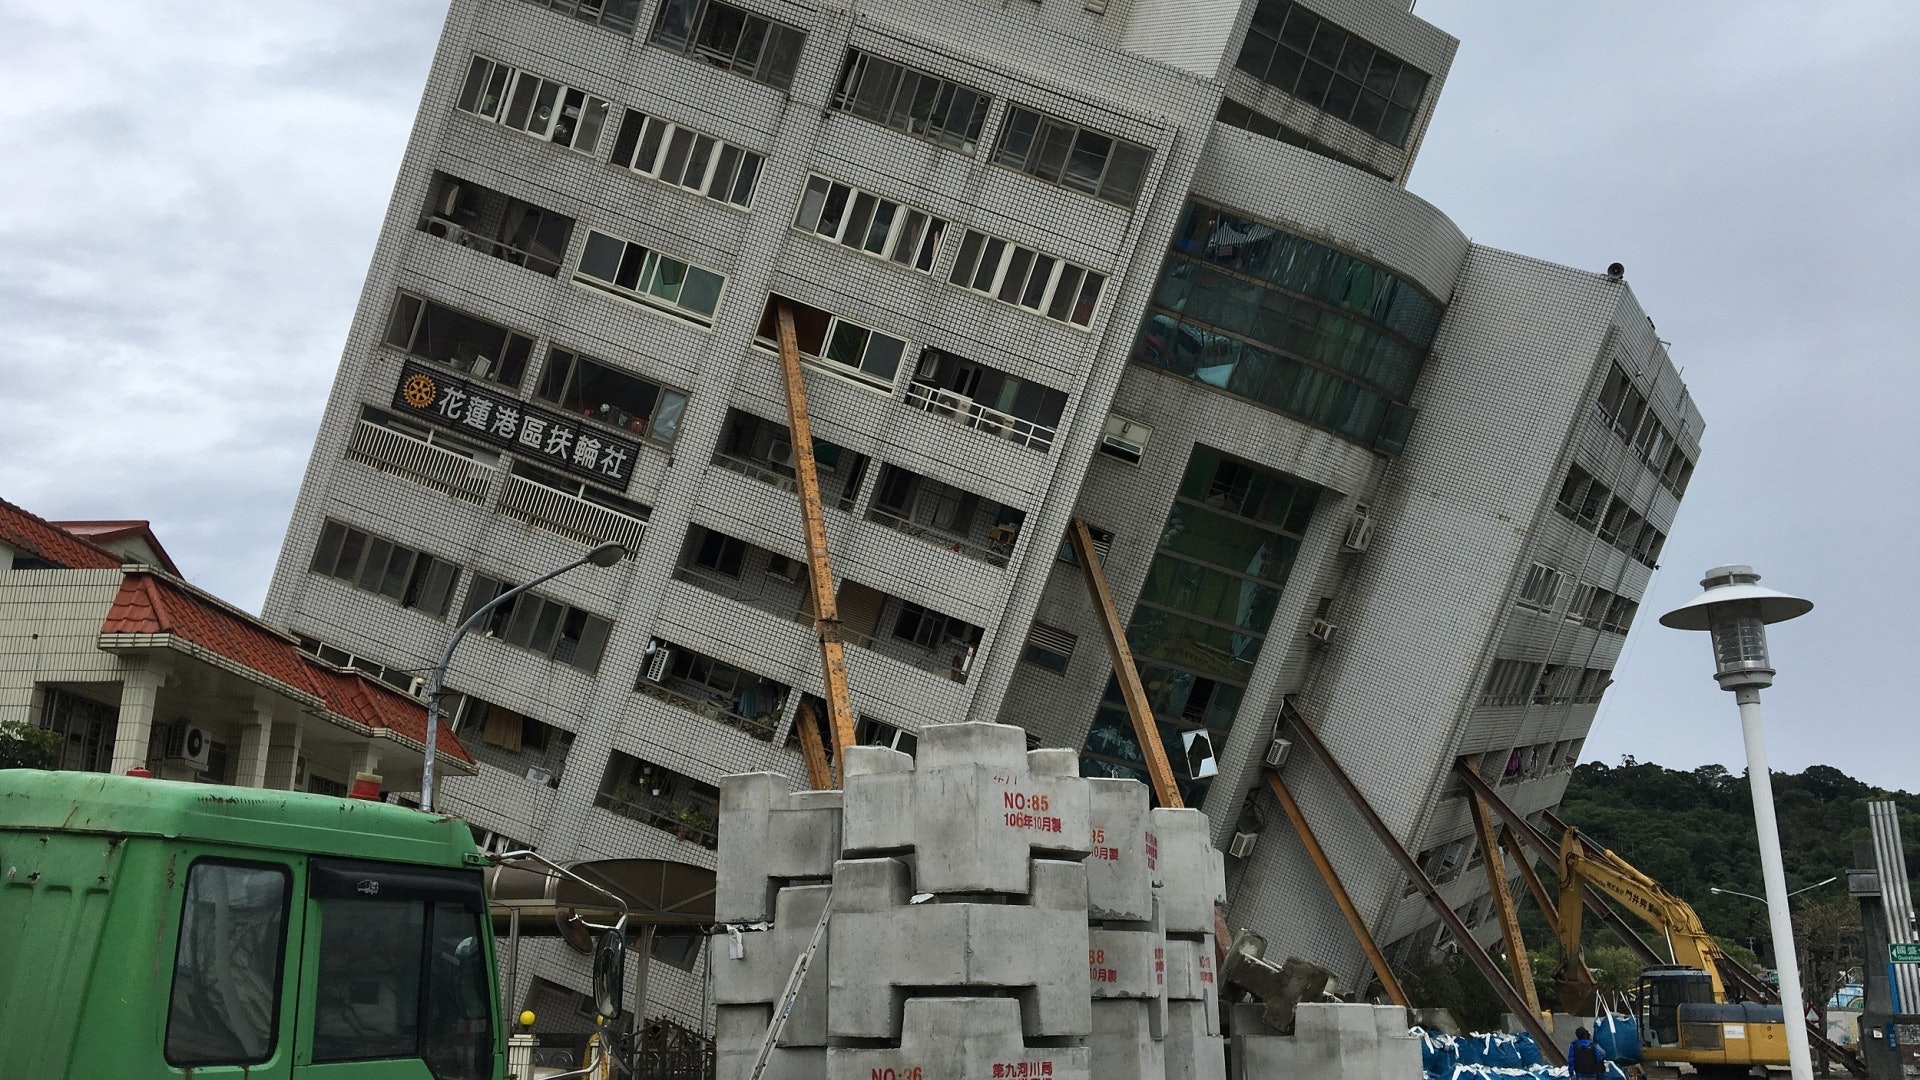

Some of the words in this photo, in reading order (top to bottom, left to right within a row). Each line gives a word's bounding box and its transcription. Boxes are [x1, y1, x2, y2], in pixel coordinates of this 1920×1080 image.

[438, 386, 628, 479] 花蓮港區扶輪社
[1004, 792, 1048, 811] NO:85
[992, 1061, 1053, 1078] 第九河川局
